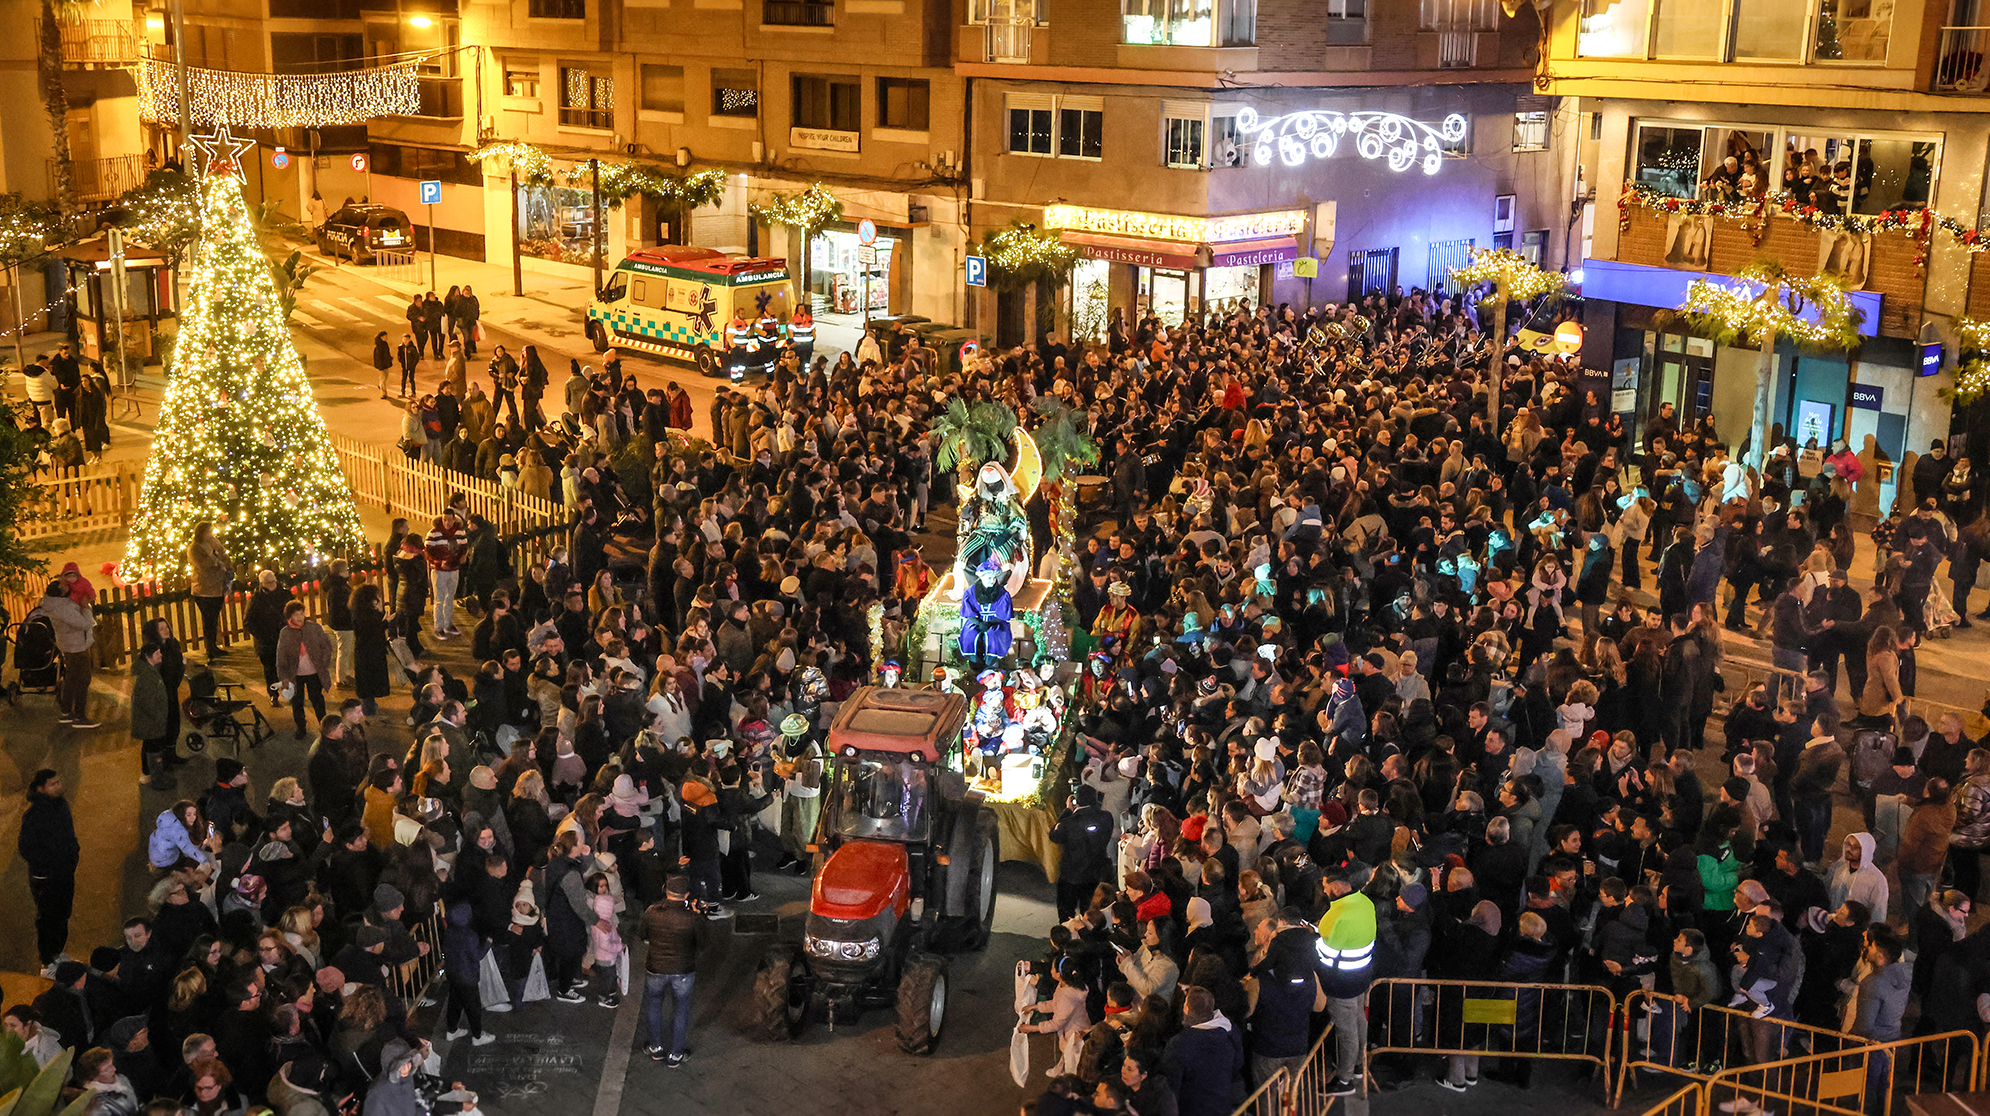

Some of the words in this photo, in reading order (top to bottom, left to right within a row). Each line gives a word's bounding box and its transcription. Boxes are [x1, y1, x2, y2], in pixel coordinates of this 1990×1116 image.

[829, 134, 853, 143] CHILDREN
[424, 184, 437, 202] P
[1083, 246, 1163, 265] Pastisseria
[1226, 250, 1284, 267] Pasteleria
[633, 263, 668, 274] AMBULANCIA
[969, 259, 981, 282] P
[735, 271, 785, 284] AMBULANCIA
[1922, 354, 1940, 366] BBVA
[1584, 368, 1604, 378] BBVA
[1853, 391, 1877, 402] BBVA
